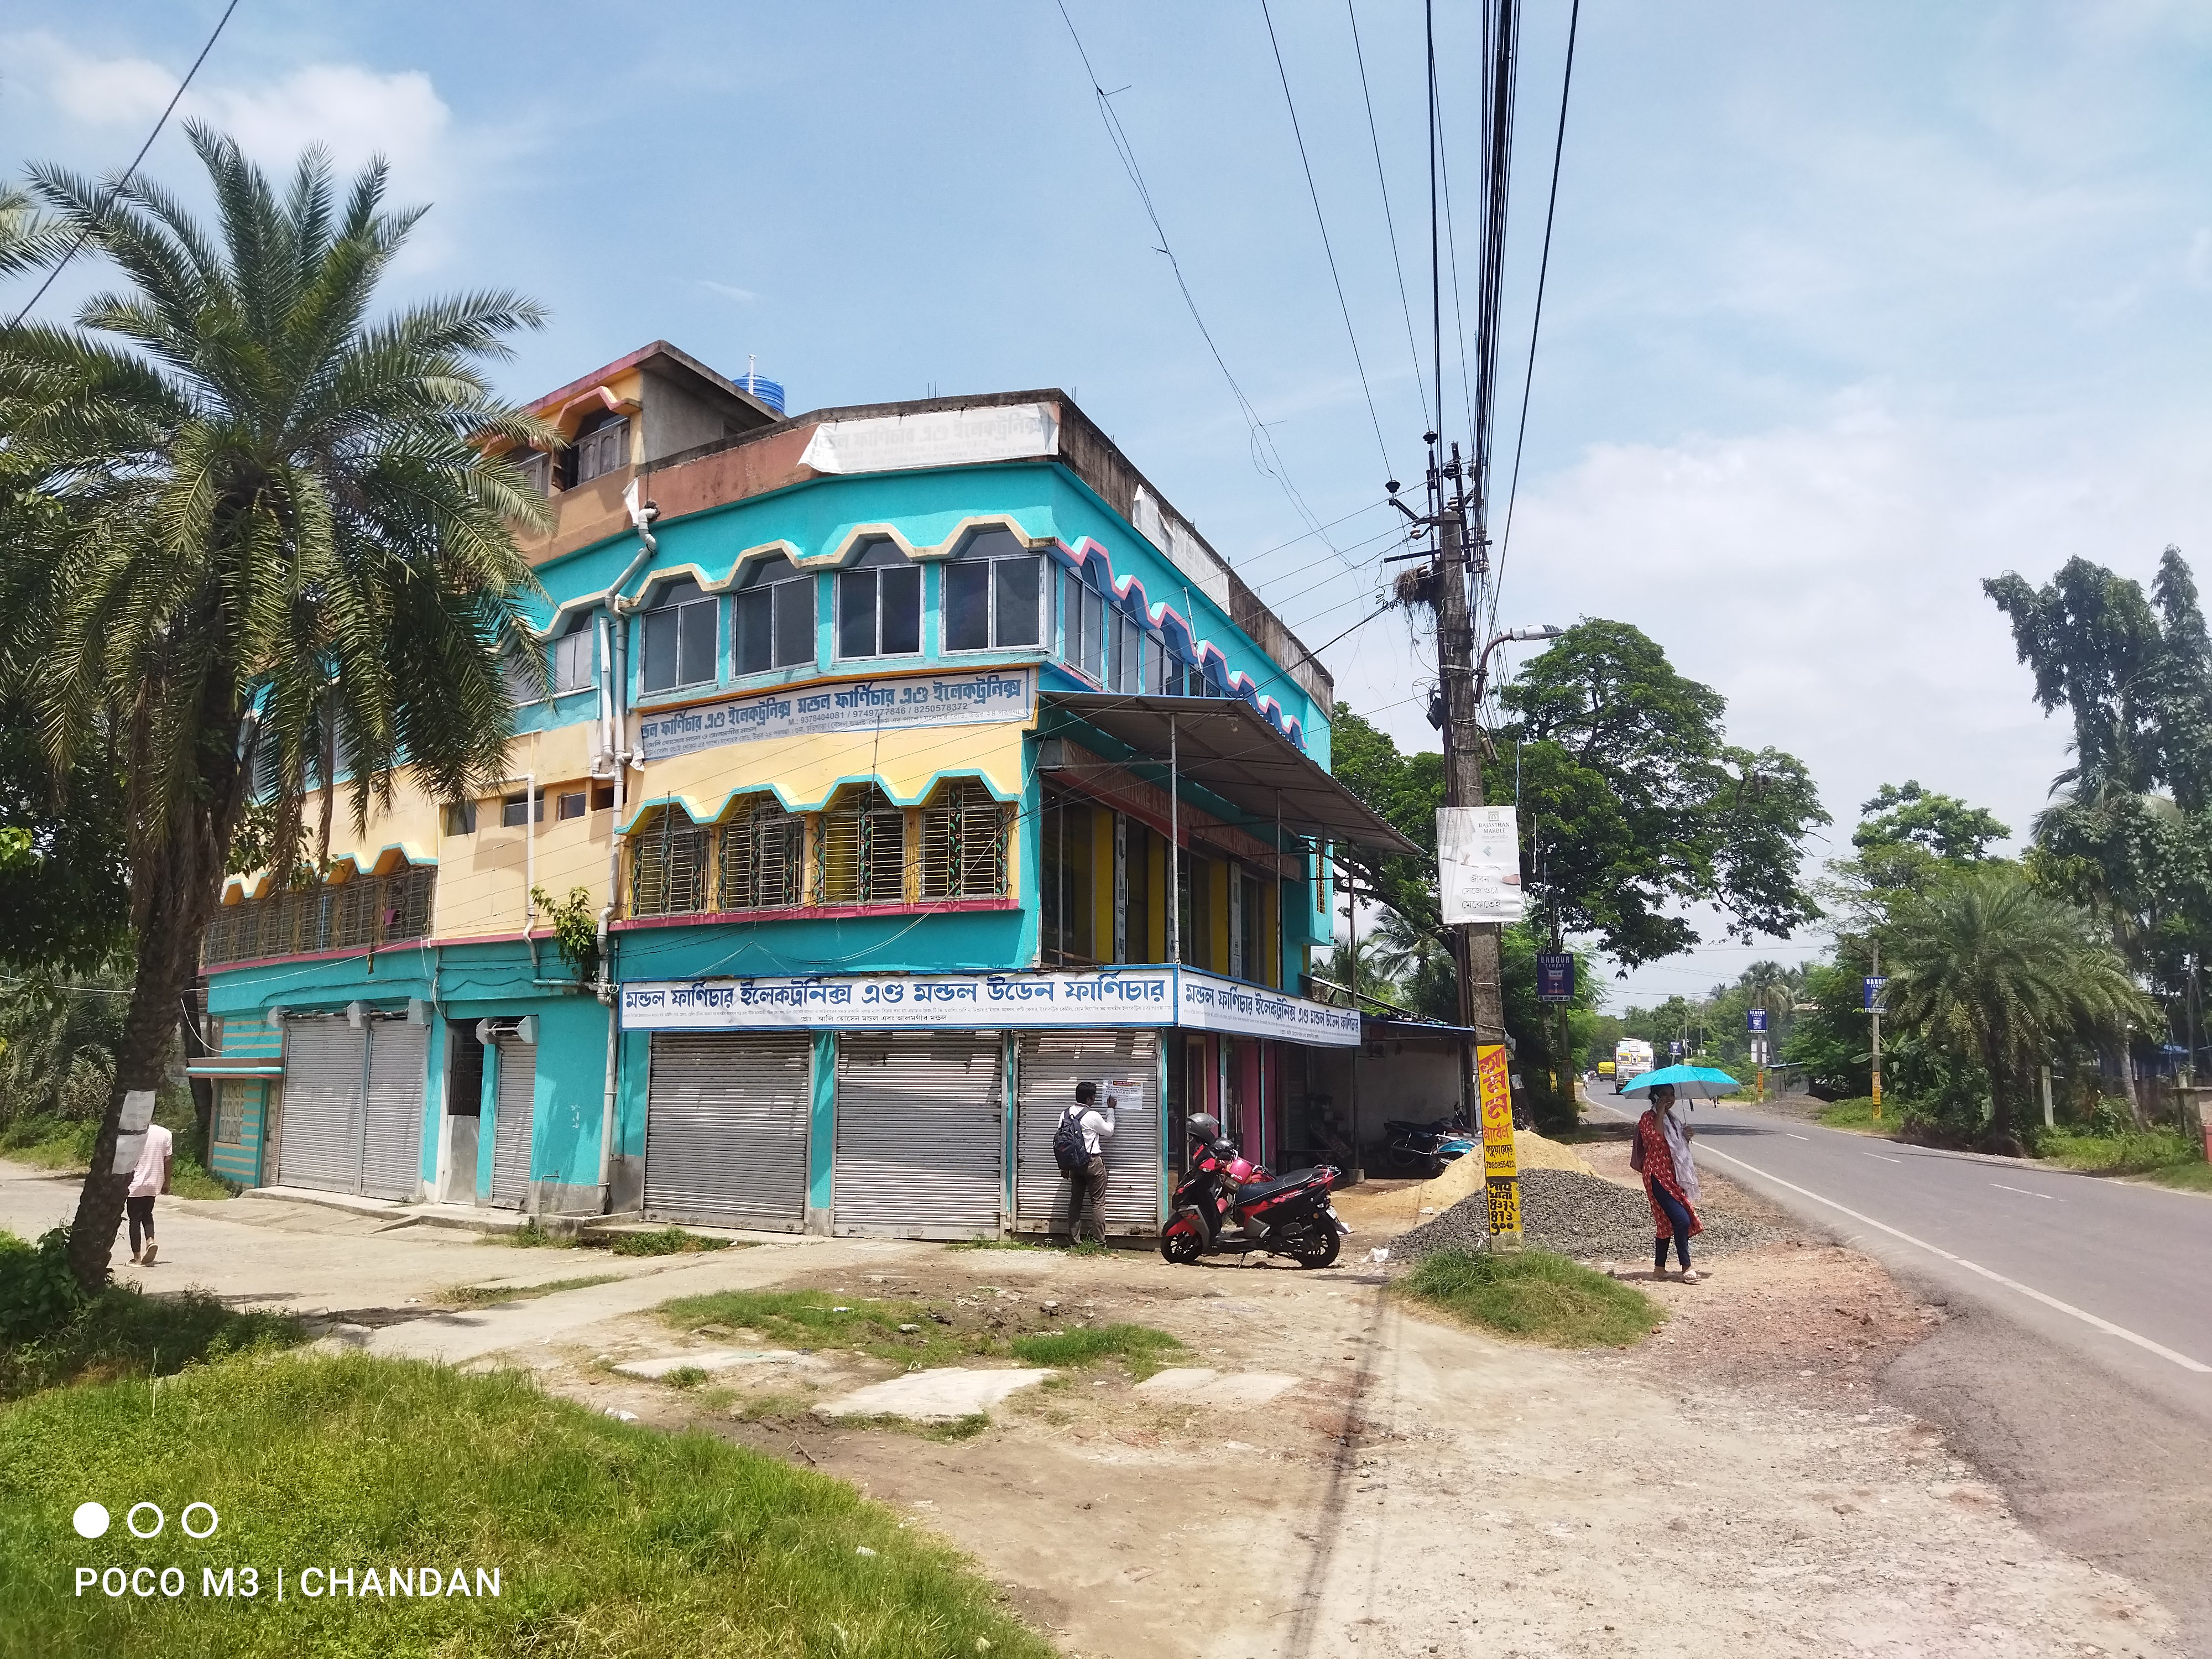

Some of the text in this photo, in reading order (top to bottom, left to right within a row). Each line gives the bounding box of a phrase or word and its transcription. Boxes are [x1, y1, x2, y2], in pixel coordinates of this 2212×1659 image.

[800, 712, 844, 723] 9378404081
[853, 707, 906, 718] 9749777846
[914, 702, 968, 713] 8250578372
[1470, 874, 1490, 883] জীবন
[1462, 898, 1501, 909] মেঝেতেই
[740, 979, 852, 1009] ইলেকট্রনিক্স
[987, 974, 1055, 1003] উডেন
[896, 1013, 927, 1021] আলমগীর
